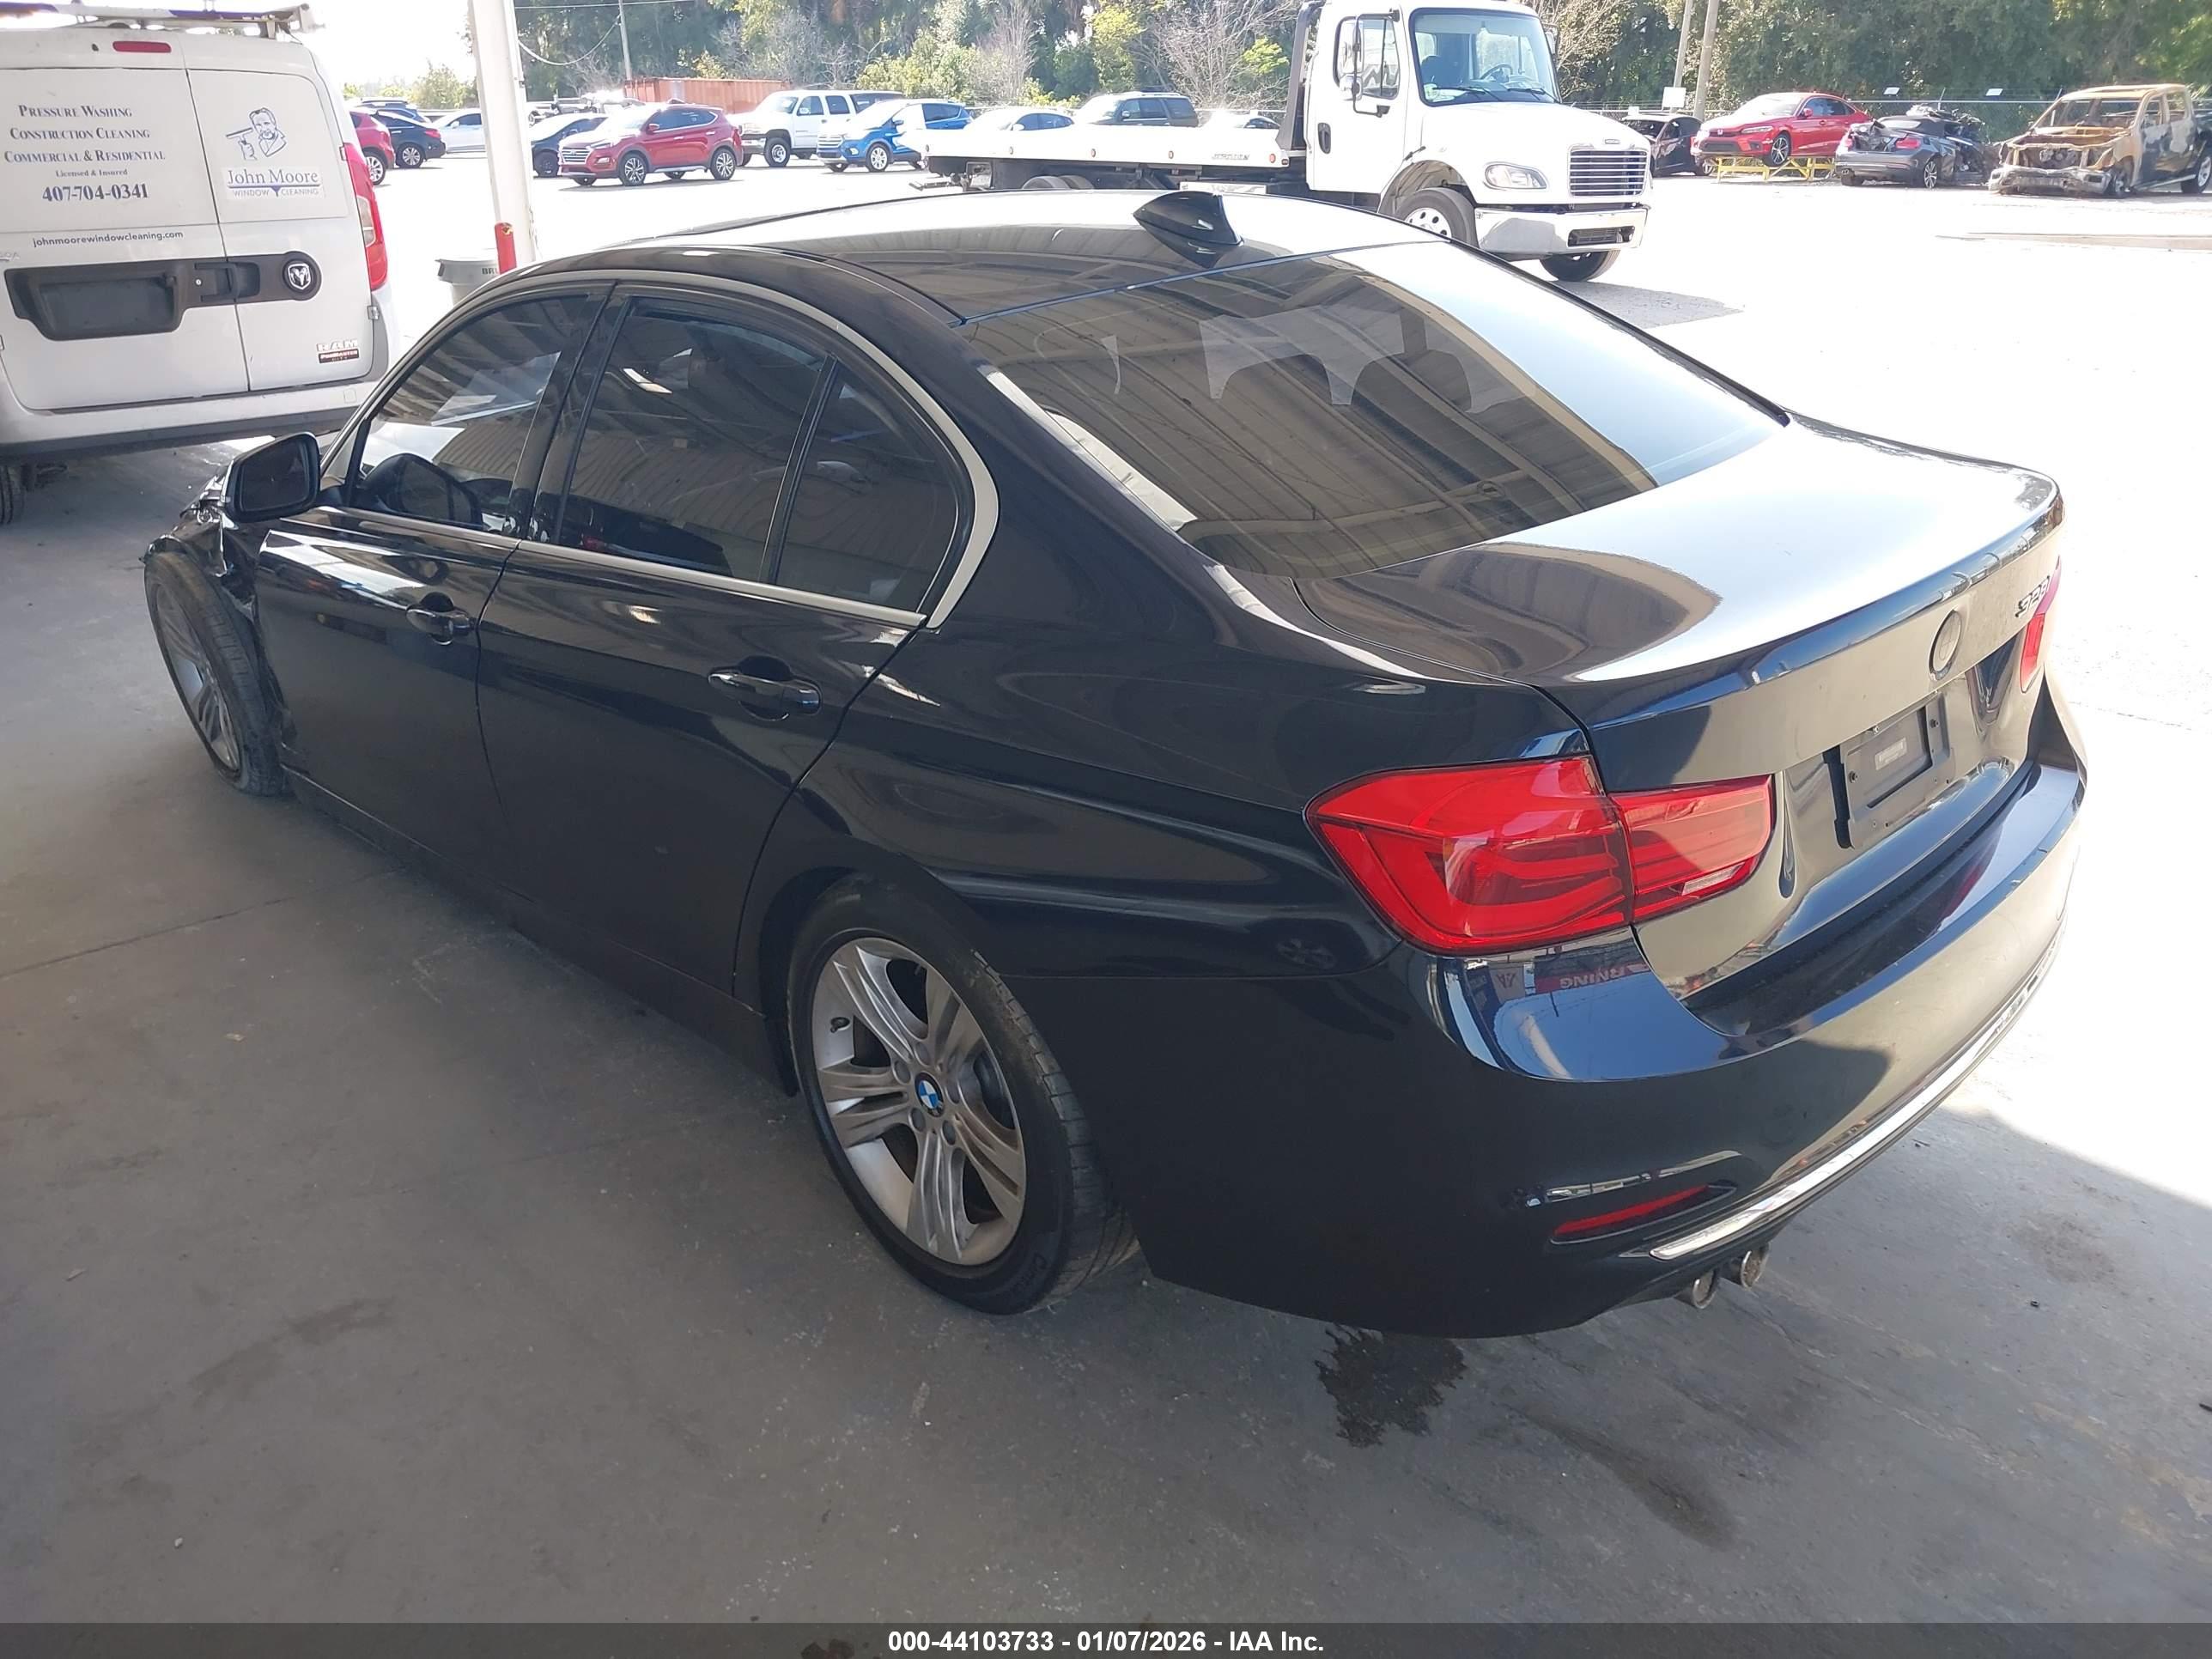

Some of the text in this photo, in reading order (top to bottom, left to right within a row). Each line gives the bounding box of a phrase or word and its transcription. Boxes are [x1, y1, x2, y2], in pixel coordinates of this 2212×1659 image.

[83, 149, 93, 161] &
[228, 168, 319, 184] John Moore
[42, 183, 149, 202] 407-704-0341
[233, 187, 319, 198] WINDOW CLEANING
[33, 231, 183, 247] johnmoorewindowcleaning.com
